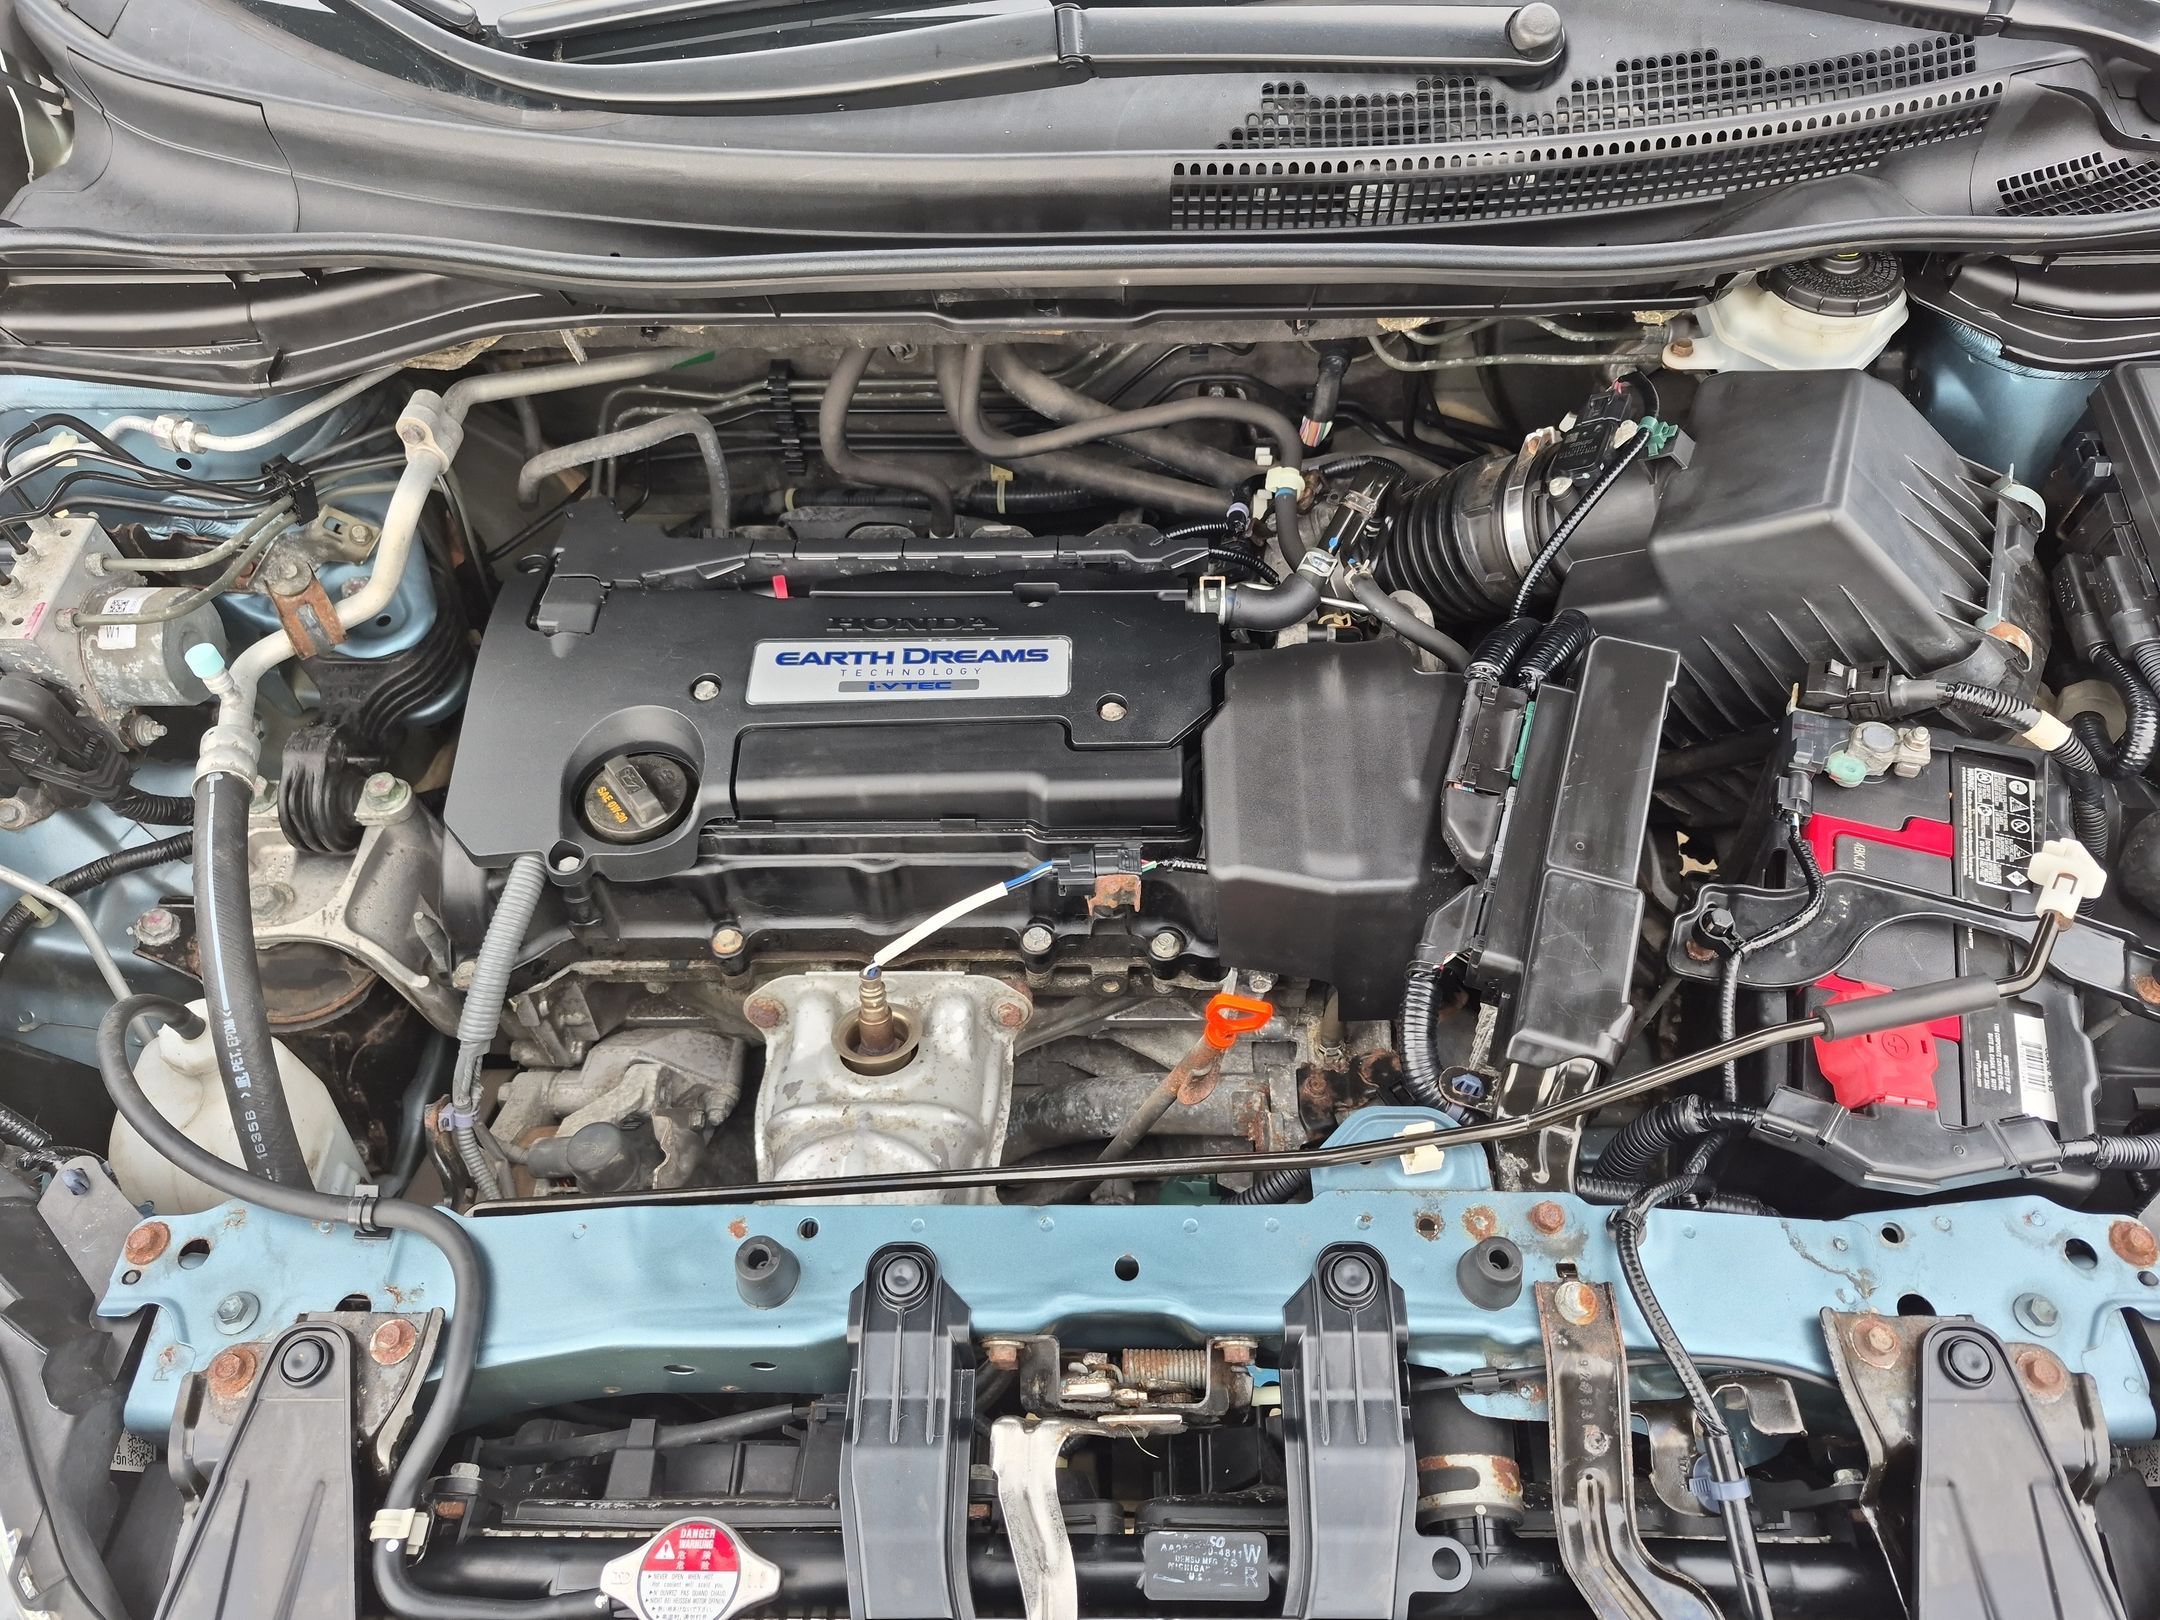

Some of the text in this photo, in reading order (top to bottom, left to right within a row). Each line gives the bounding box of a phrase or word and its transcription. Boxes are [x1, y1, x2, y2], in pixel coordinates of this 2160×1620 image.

[826, 616, 999, 632] HONDA
[775, 648, 1048, 665] EARTH DREAMS
[841, 668, 982, 677] TECHNOLOGY
[869, 680, 952, 692] i-VTEC
[597, 786, 614, 803] SAE
[245, 1109, 267, 1160] 1635B
[680, 1528, 716, 1538] DANGER
[679, 1540, 714, 1549] WARNUNG
[1243, 1543, 1261, 1564] W
[1244, 1566, 1258, 1588] R
